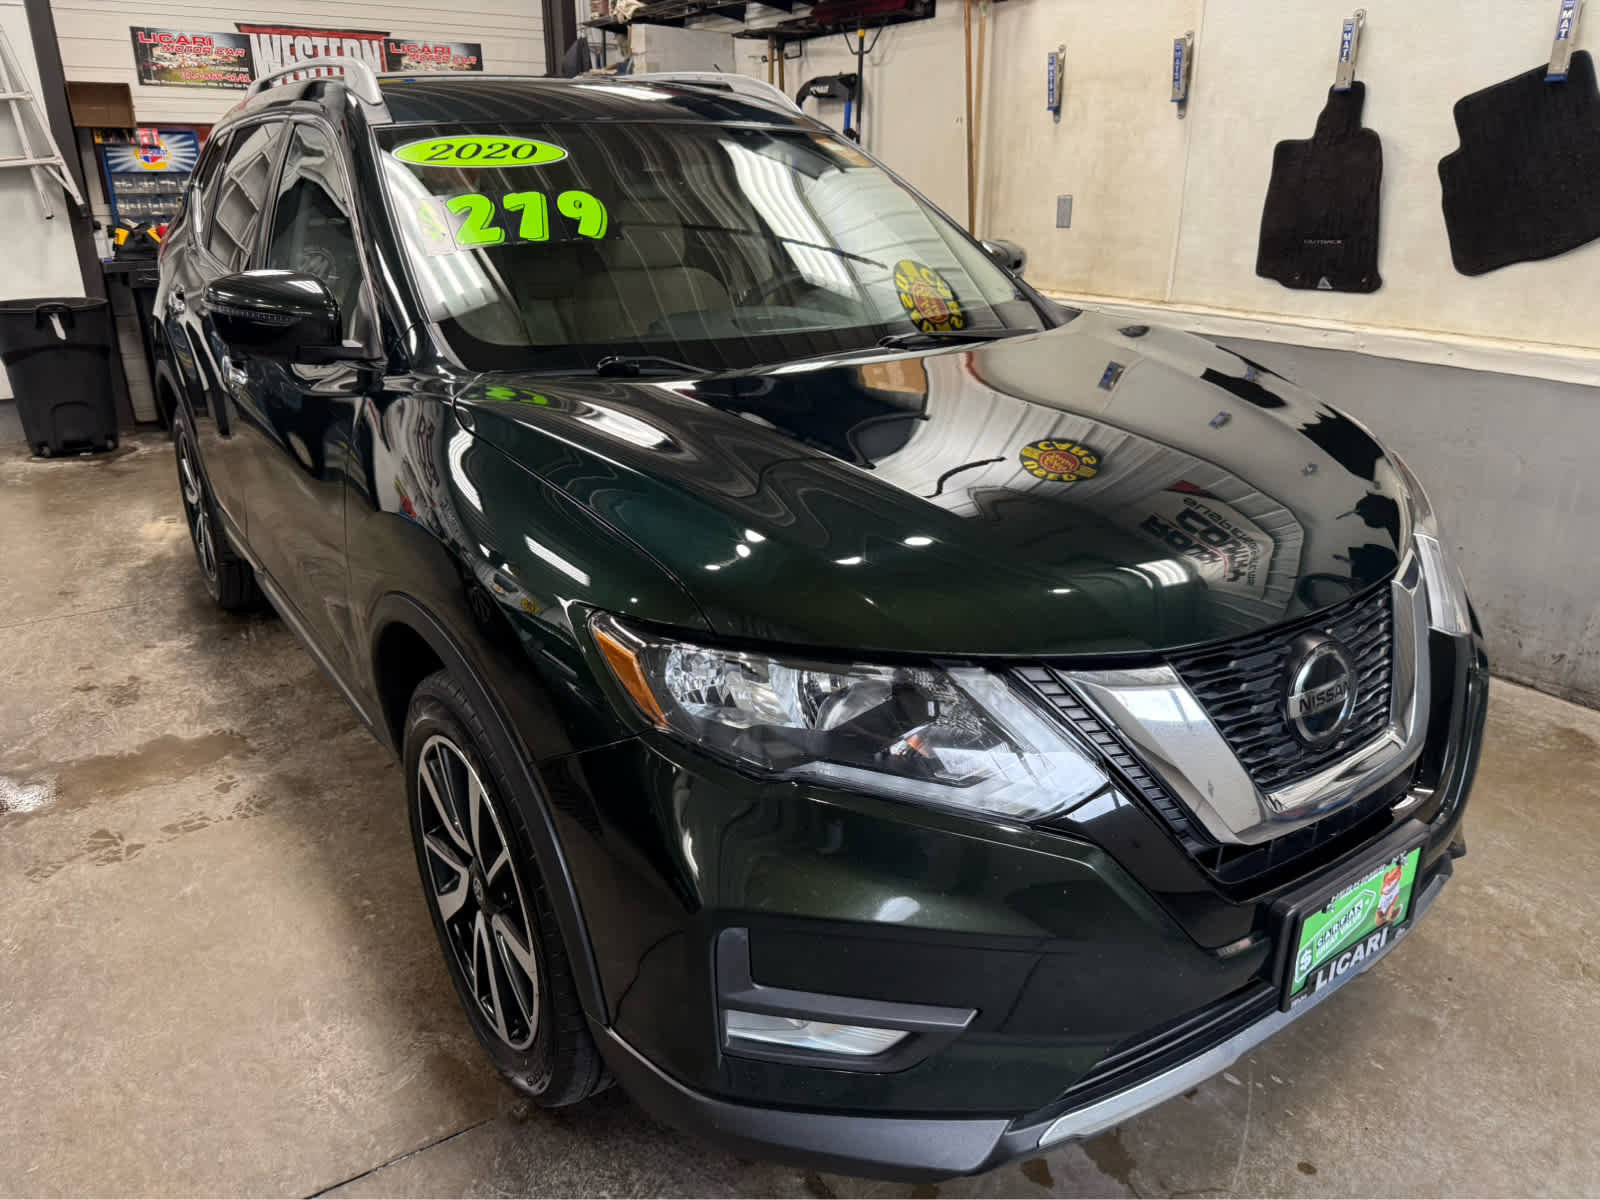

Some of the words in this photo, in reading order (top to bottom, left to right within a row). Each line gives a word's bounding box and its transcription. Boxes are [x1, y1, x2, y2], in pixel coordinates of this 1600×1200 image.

[138, 31, 214, 47] LICARI
[161, 44, 213, 56] MOTOR
[216, 48, 246, 57] CAR
[250, 33, 382, 82] WESTERN
[390, 43, 451, 57] LICARI
[425, 143, 538, 161] 2020
[1299, 680, 1350, 713] NISSAN
[1315, 927, 1389, 993] LICARI
